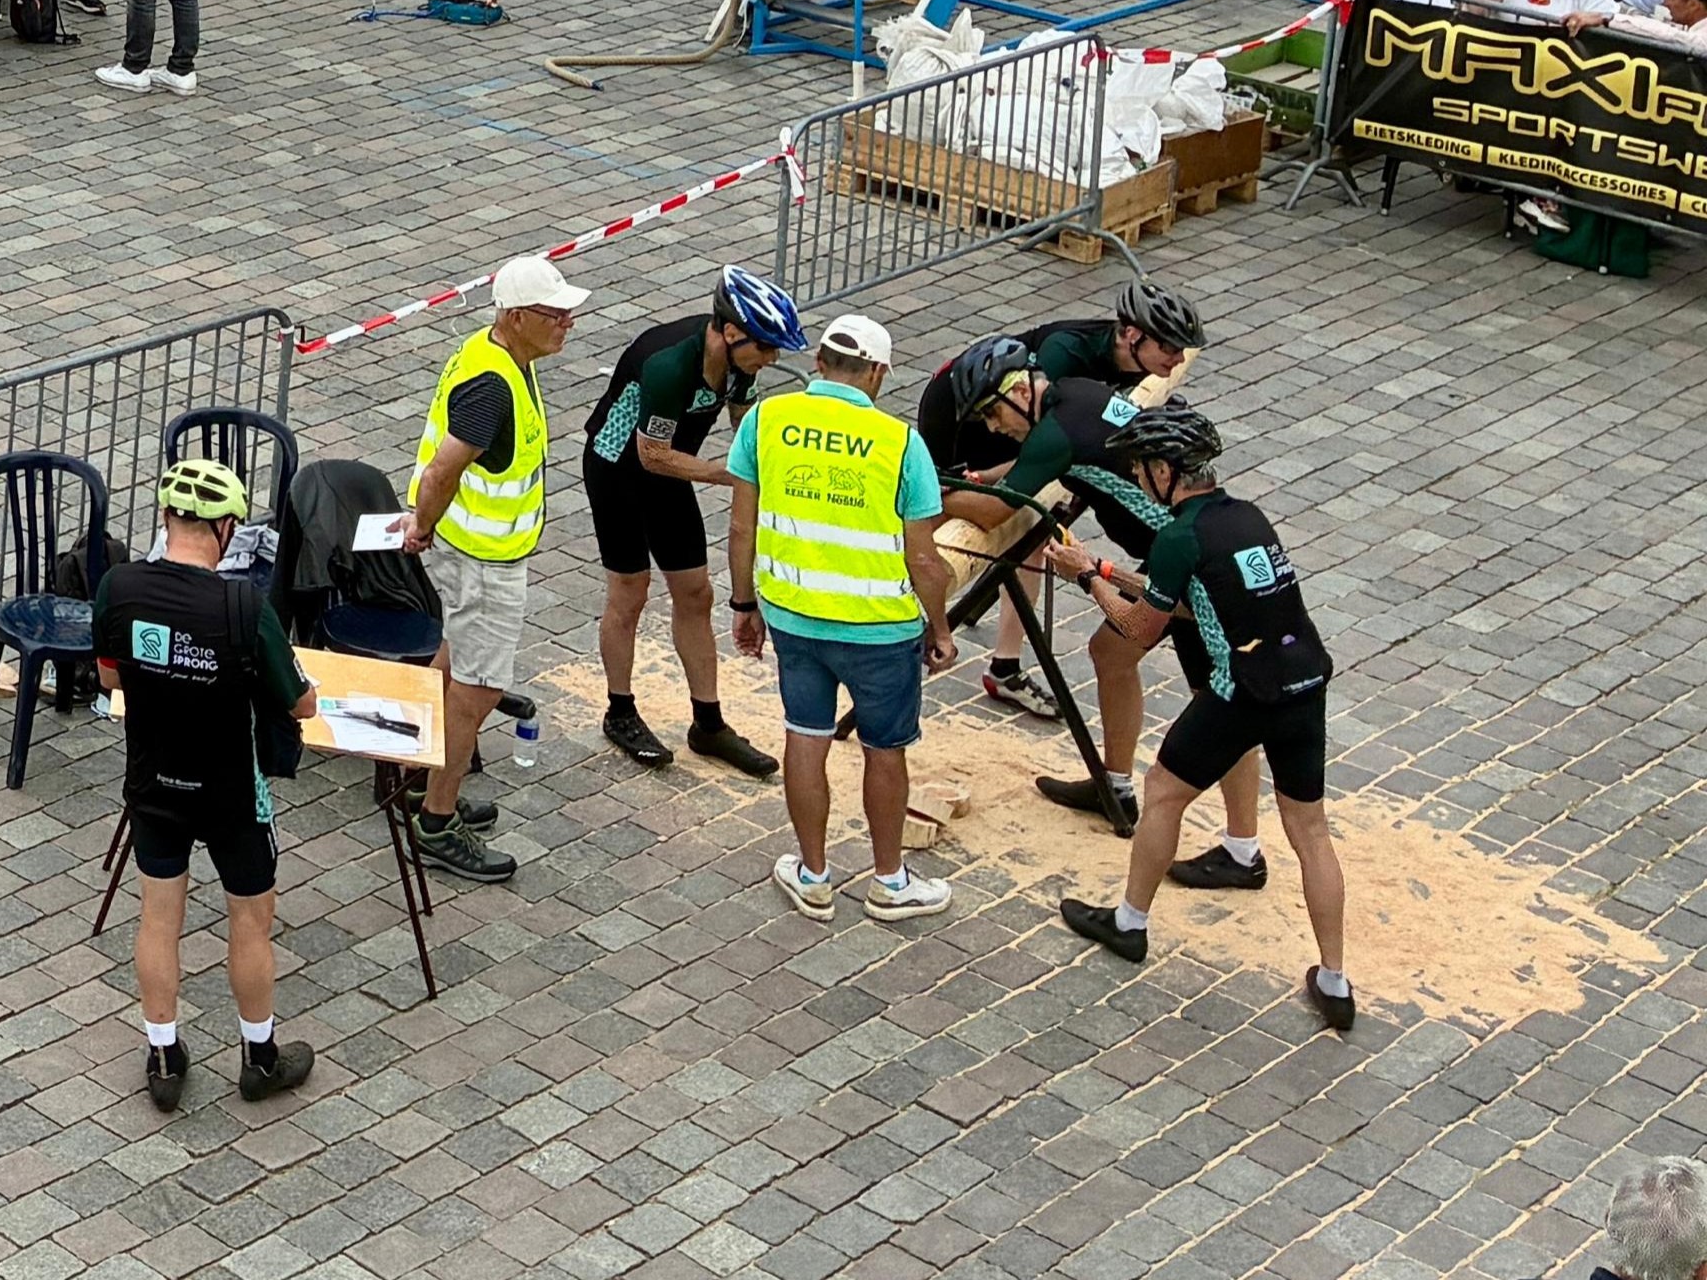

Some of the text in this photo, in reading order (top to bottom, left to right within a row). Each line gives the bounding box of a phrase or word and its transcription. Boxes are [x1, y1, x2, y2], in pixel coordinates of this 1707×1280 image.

[1365, 8, 1707, 133] MAXIP
[1365, 123, 1472, 157] FIETSKLEDING
[781, 424, 874, 458] CREW
